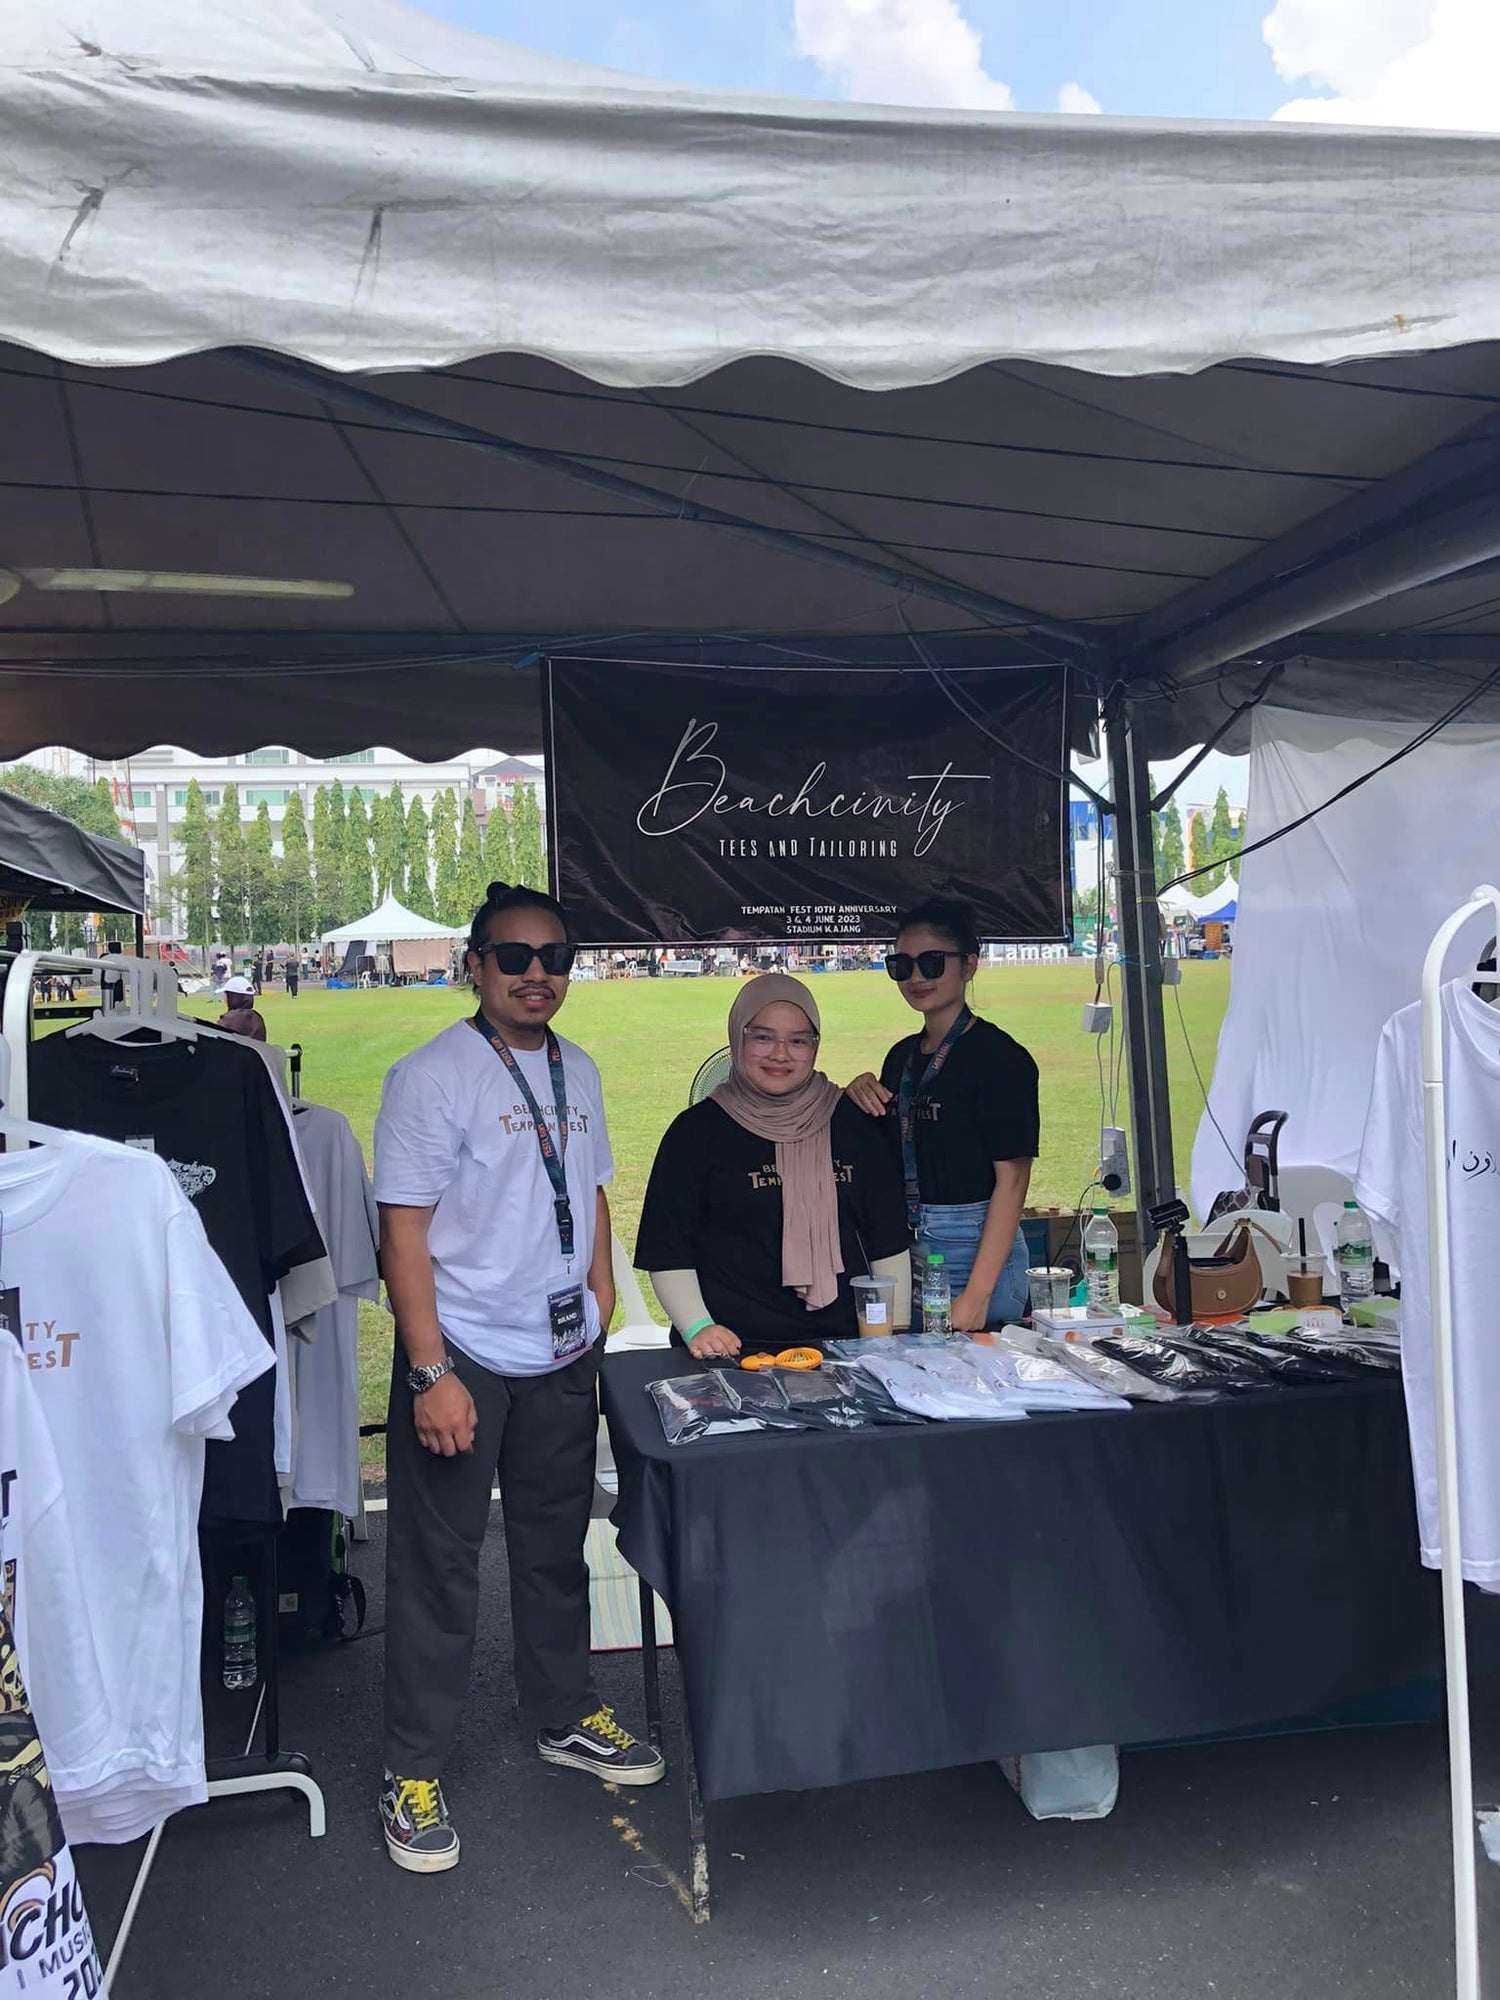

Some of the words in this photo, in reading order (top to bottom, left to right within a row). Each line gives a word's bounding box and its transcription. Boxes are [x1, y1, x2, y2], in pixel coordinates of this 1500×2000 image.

[637, 718, 991, 857] Beachcinity
[719, 839, 758, 857] TEES
[768, 839, 798, 857] AND
[809, 837, 897, 857] TAILORING
[741, 905, 786, 914] TEMPATAN
[790, 905, 812, 914] FEST
[814, 905, 836, 914] 10TH
[838, 905, 897, 914] ANNIVERSARY
[785, 915, 792, 924] 3
[794, 916, 803, 924] &
[805, 916, 812, 924] 4
[815, 915, 835, 923] JUNE
[837, 915, 861, 923] 2023
[786, 925, 823, 934] STADIUM
[824, 925, 861, 934] KAJANG
[988, 942, 1068, 962] Laman
[512, 1103, 578, 1116] BEHCITY
[499, 1114, 556, 1135] TEMPN
